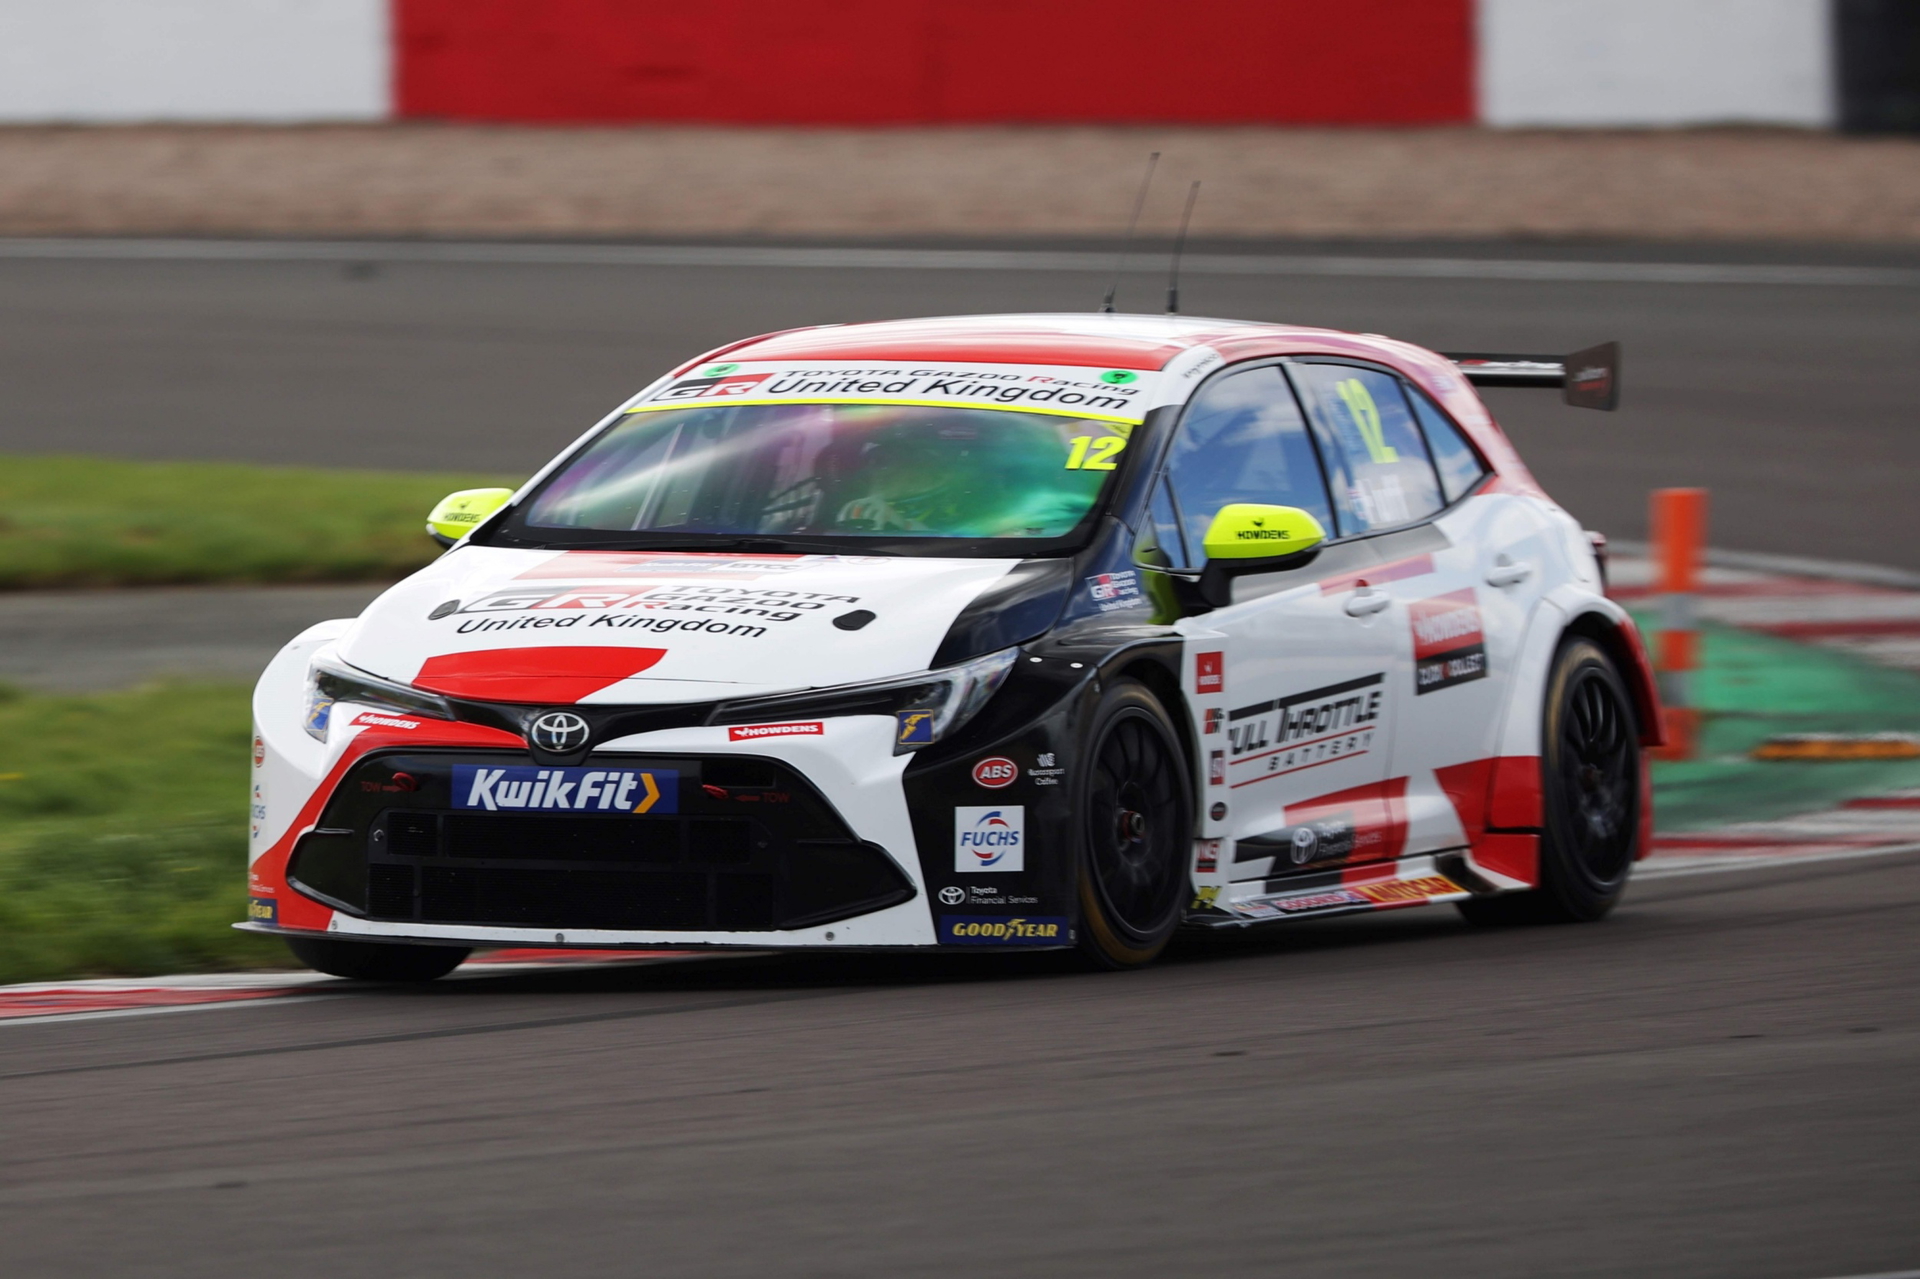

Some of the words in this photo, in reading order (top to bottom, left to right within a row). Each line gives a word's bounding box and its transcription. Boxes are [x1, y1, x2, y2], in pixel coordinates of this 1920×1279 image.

[782, 369, 902, 378] TOYOTA
[1027, 375, 1141, 397] Racing
[768, 378, 911, 394] United
[921, 379, 1131, 410] Kingdom
[1336, 378, 1400, 465] 12
[1064, 435, 1128, 471] 12
[1235, 529, 1291, 540] HOWDENS
[671, 585, 862, 604] TOYOTA
[622, 600, 803, 622] Racing
[456, 614, 587, 634] United
[588, 613, 768, 638] Kingdom
[1275, 686, 1383, 744] THROTTLE
[749, 724, 819, 736] HOWDENS
[1267, 732, 1375, 771] BATTERY
[980, 764, 1013, 779] ABS
[361, 780, 382, 792] TOW
[763, 793, 790, 804] TOW
[960, 830, 1020, 847] FUCHS
[970, 896, 1007, 905] Financial
[1008, 896, 1039, 904] Services
[971, 886, 998, 896] Toyota
[952, 919, 1059, 940] GOODYEAR
